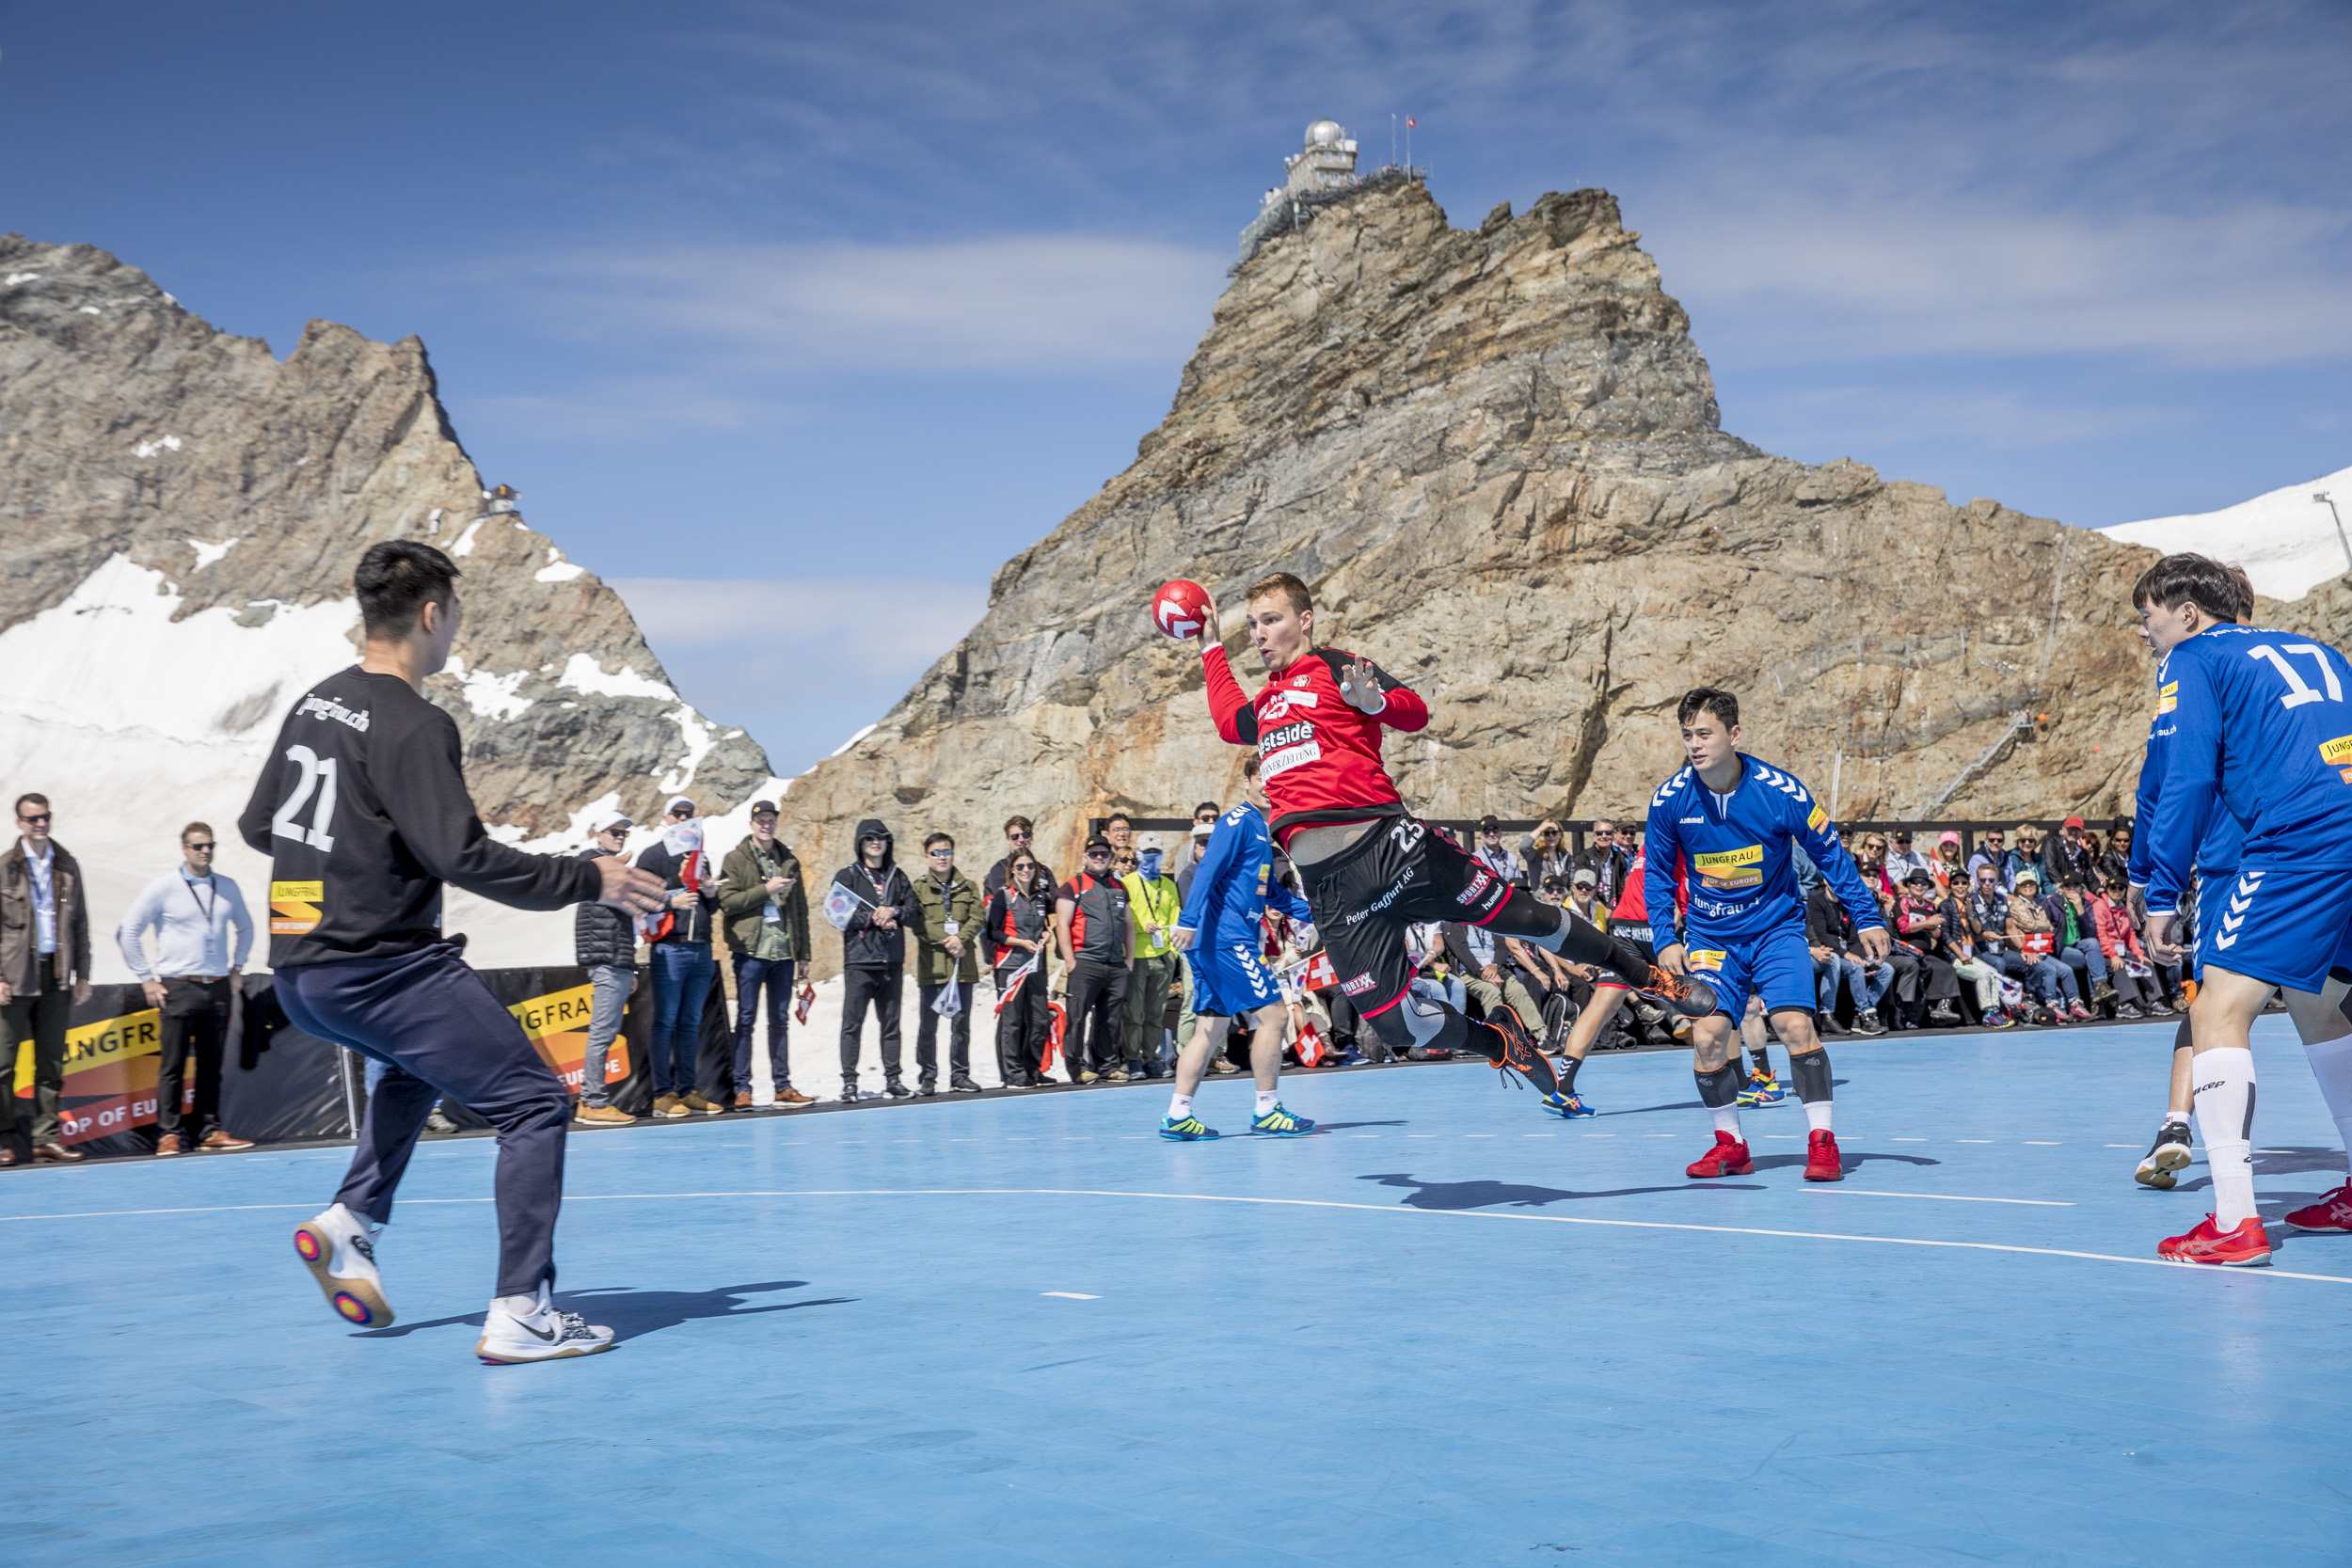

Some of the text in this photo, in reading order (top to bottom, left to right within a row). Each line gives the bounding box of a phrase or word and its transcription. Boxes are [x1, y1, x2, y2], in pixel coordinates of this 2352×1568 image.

[2246, 643, 2344, 710] 17
[272, 744, 338, 852] 21
[1679, 816, 1705, 824] ummel
[1391, 818, 1425, 853] 23
[1822, 830, 1838, 847] jungfr
[1701, 850, 1754, 865] JUNGFRAU
[1345, 866, 1414, 926] Peter Gaffuri AG
[1455, 869, 1489, 904] SPORTXX
[1705, 877, 1719, 885] TOP
[1729, 876, 1759, 886] EUROPE
[1481, 882, 1504, 911] hummel
[1693, 894, 1760, 917] jungfrau
[1340, 972, 1376, 992] PORTXX
[516, 993, 594, 1030] GFRA
[61, 1022, 156, 1066] UNGFR
[62, 1117, 92, 1136] OP
[98, 1106, 127, 1126] OF
